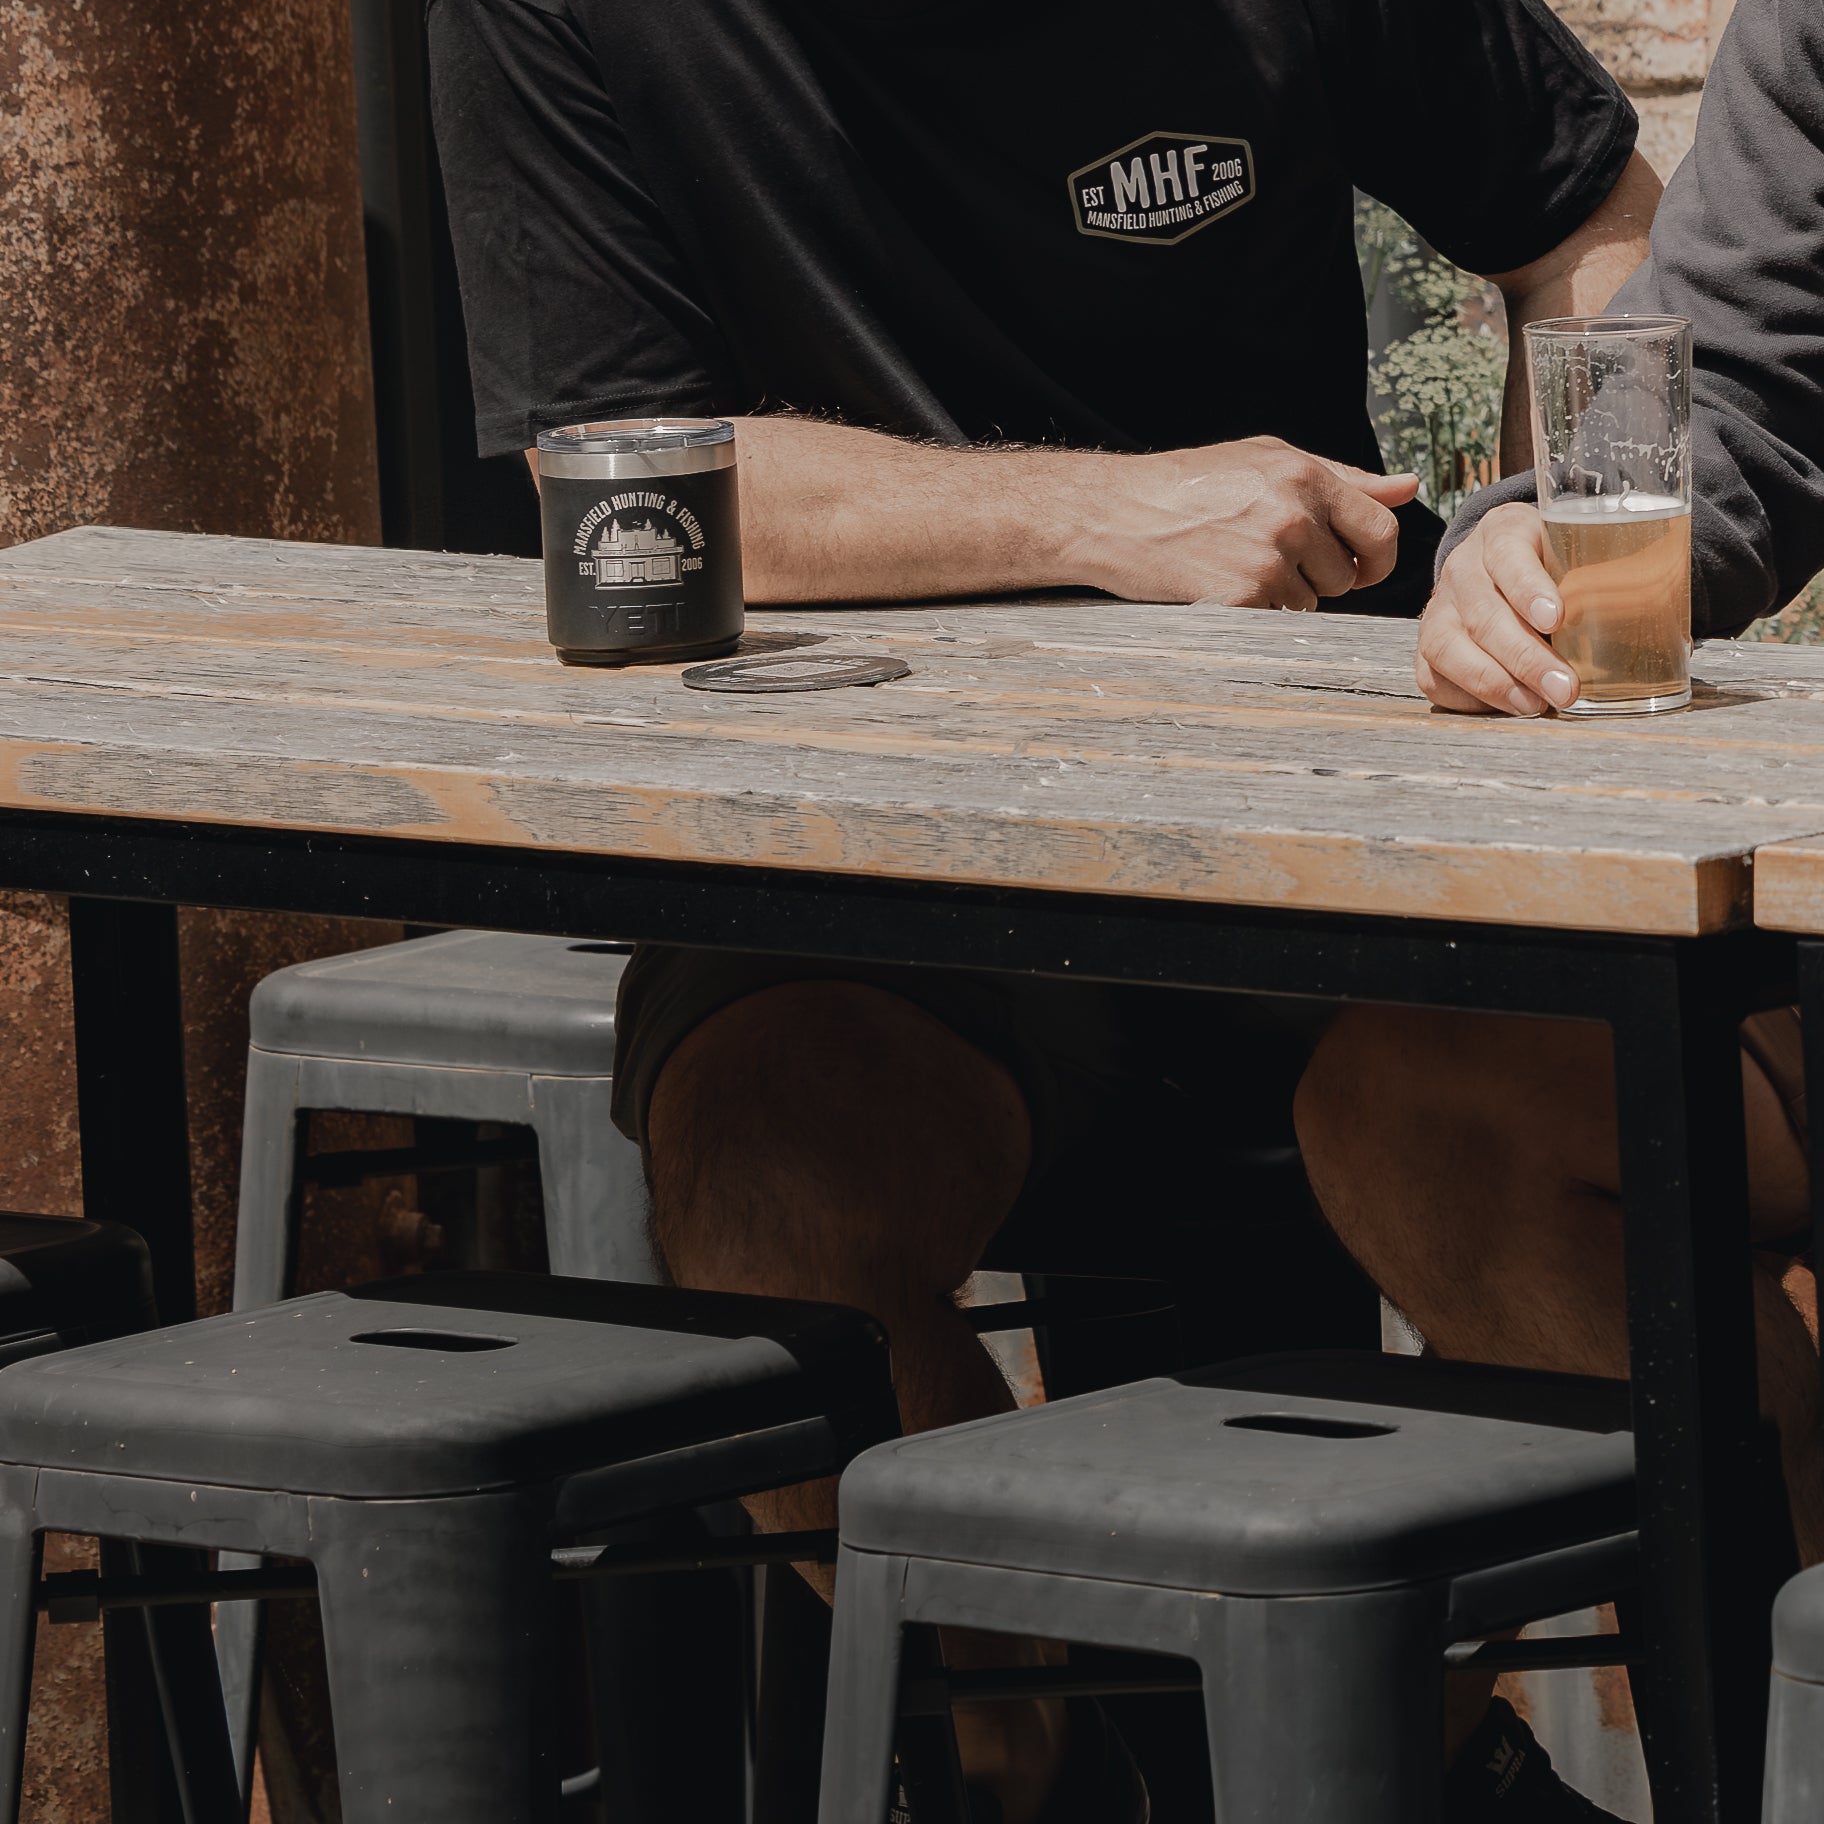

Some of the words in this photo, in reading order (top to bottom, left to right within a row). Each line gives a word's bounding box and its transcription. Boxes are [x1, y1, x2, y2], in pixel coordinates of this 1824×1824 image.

[1082, 186, 1104, 207] EST
[1110, 144, 1208, 213] MHF
[1211, 158, 1242, 181] 2006
[1087, 210, 1147, 230] MANSFIELD
[1149, 202, 1193, 228] HUNTING
[1195, 200, 1204, 215] &
[1204, 180, 1244, 210] FISHING
[573, 500, 612, 555] MANSFIELD
[611, 491, 666, 511] HUNTING
[666, 500, 678, 514] &
[676, 507, 706, 550] FISHING
[681, 557, 703, 572] 2006
[588, 602, 686, 635] YETI
